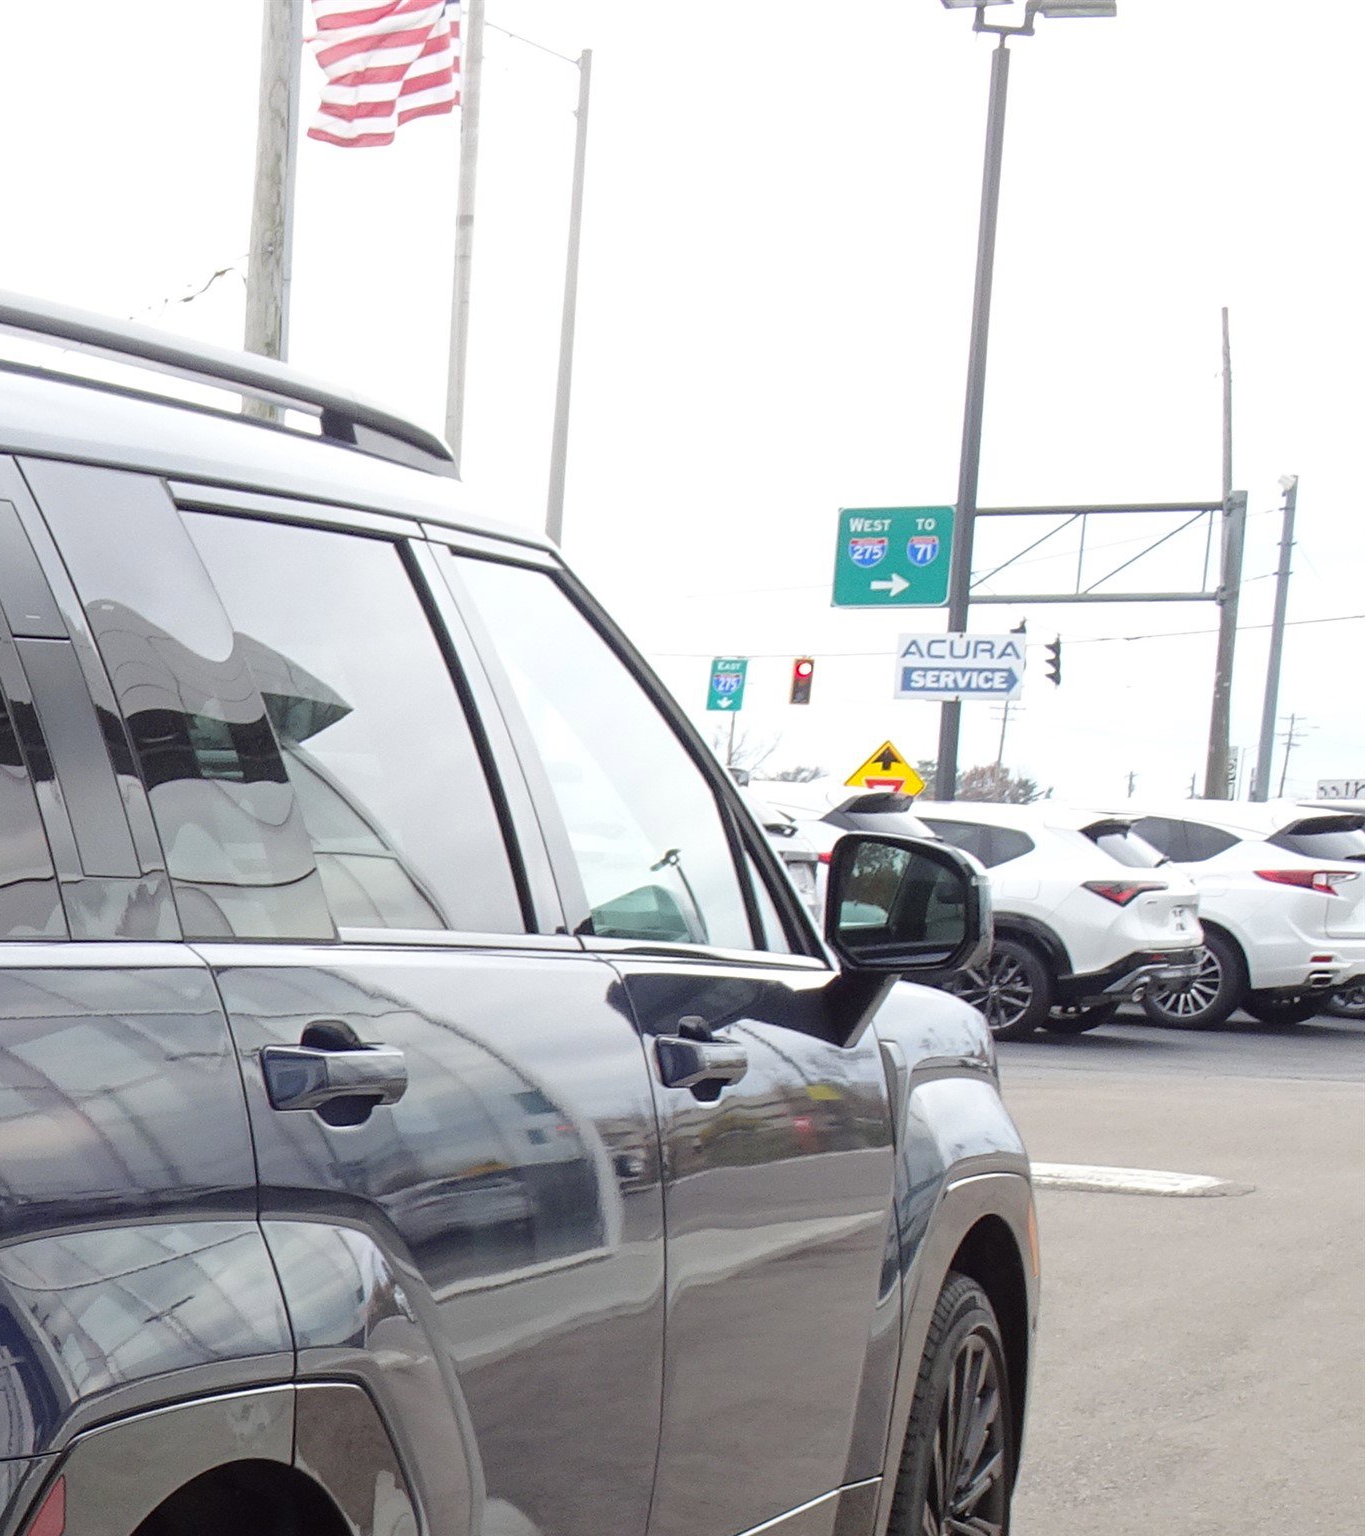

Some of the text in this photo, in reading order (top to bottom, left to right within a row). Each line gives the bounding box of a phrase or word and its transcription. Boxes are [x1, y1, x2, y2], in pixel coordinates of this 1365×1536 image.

[849, 518, 937, 532] WEST TO
[852, 544, 933, 561] 275 71
[900, 639, 1021, 660] ACURA
[910, 670, 1008, 689] SERVICE
